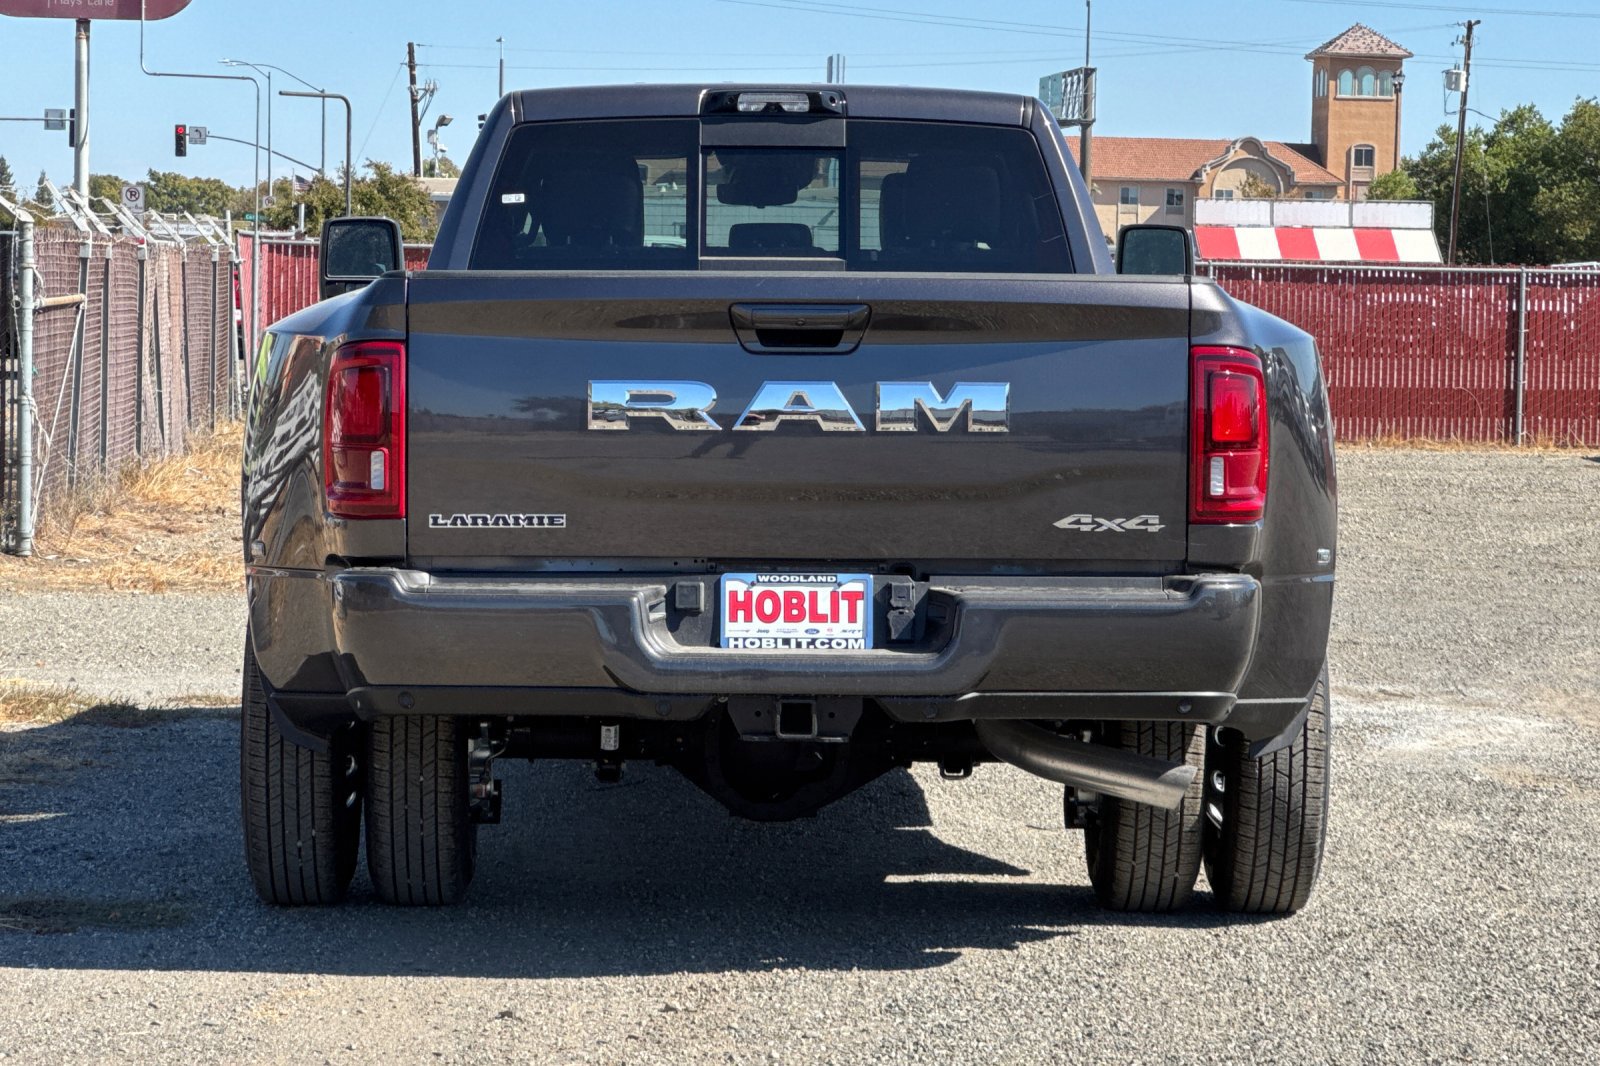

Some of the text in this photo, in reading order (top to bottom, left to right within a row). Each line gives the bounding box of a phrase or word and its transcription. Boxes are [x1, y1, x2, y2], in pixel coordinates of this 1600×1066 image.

[587, 380, 1010, 432] RAM
[429, 514, 566, 528] LARAMIE
[757, 575, 836, 583] WOODLAND
[728, 589, 864, 624] HOBLIT
[729, 638, 865, 649] HOBLIT.COM
